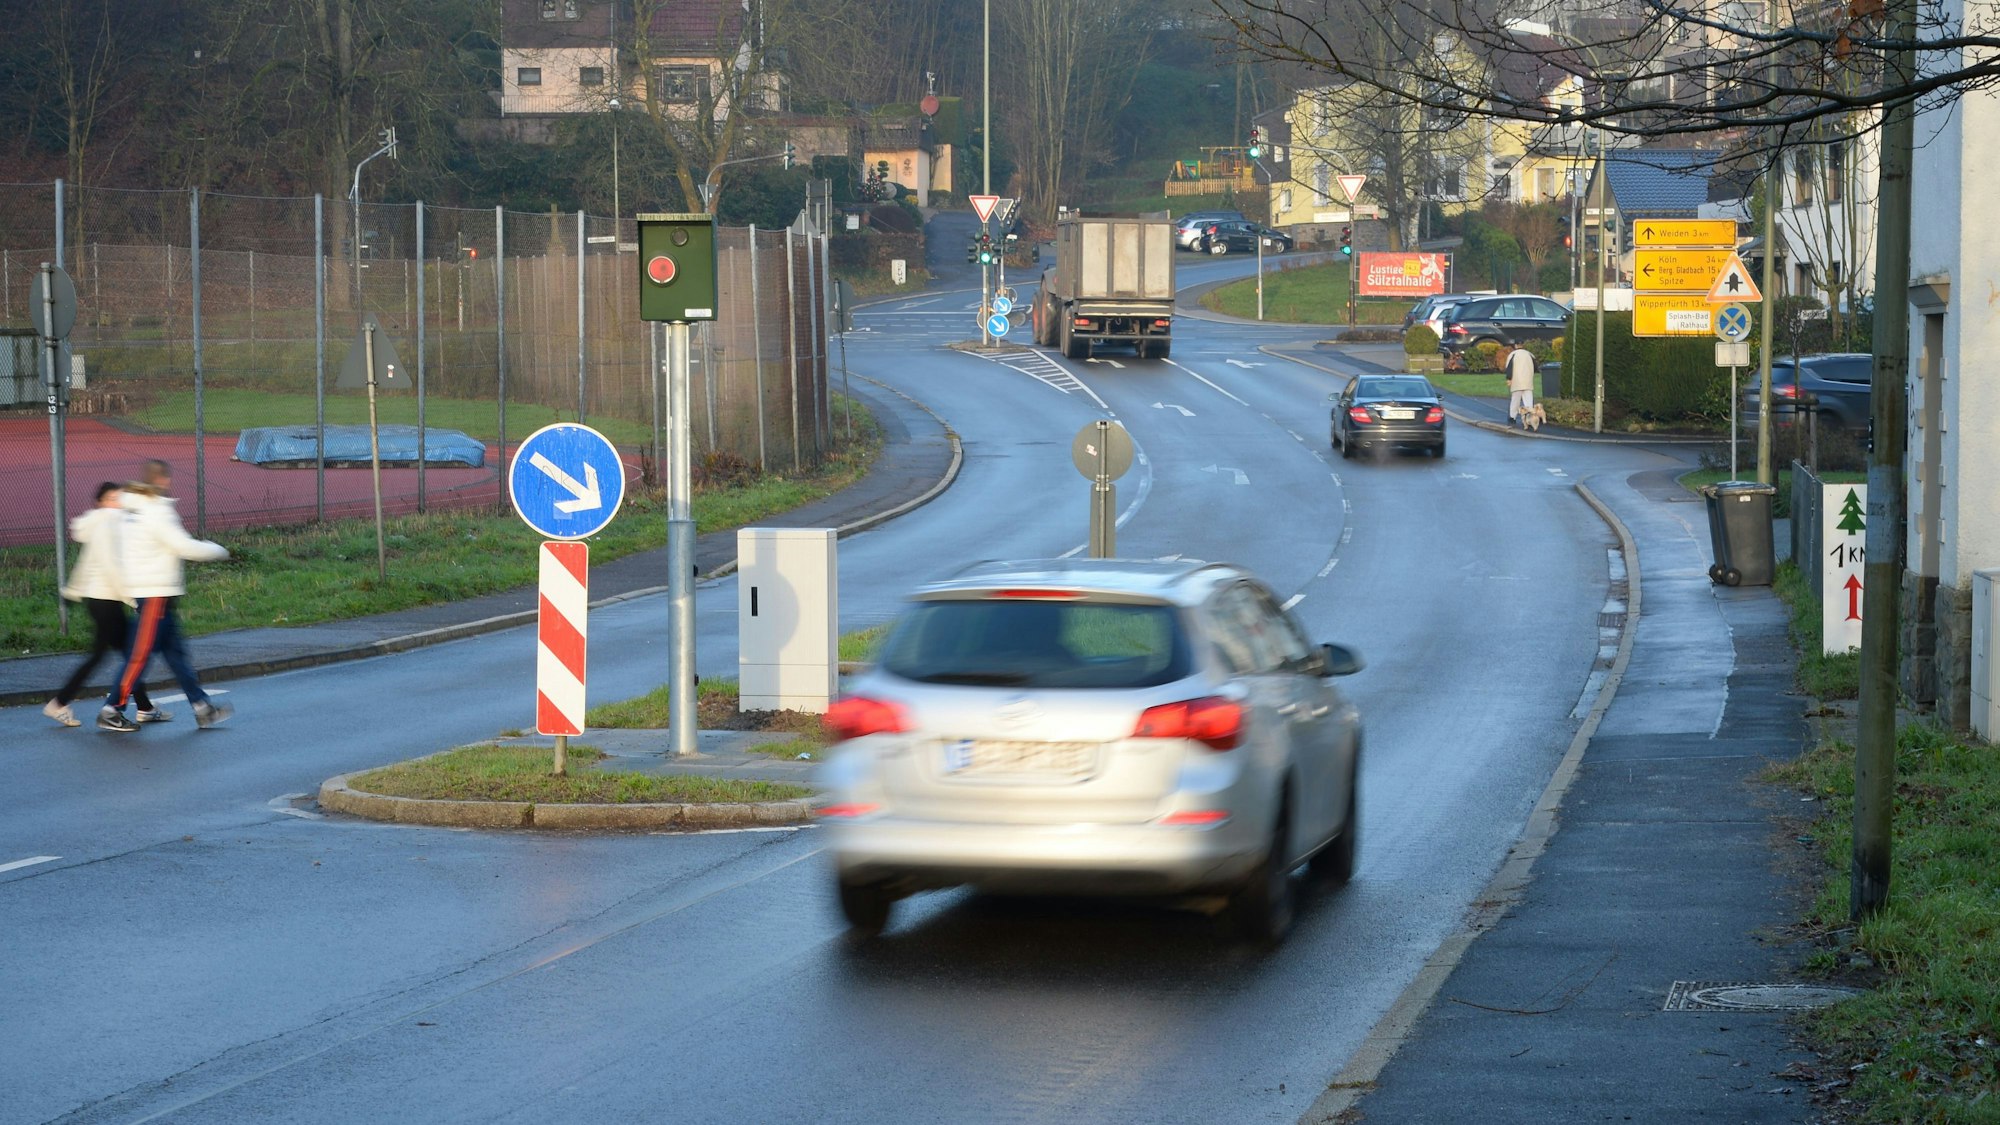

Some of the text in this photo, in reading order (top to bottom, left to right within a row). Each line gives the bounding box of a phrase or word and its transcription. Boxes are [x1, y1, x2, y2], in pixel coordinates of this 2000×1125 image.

[1659, 229, 1689, 237] Weiden
[1692, 229, 1698, 237] 3
[1659, 255, 1677, 263] Köln
[1676, 266, 1705, 274] Gladbach
[1708, 266, 1716, 274] 15
[1367, 274, 1432, 286] Sülztalhalle
[1659, 277, 1684, 286] Spitze
[1640, 300, 1688, 309] Wipperfürth
[1668, 312, 1709, 320] Splash-Bad
[1680, 321, 1709, 329] Rathaus
[1830, 543, 1844, 568] 1
